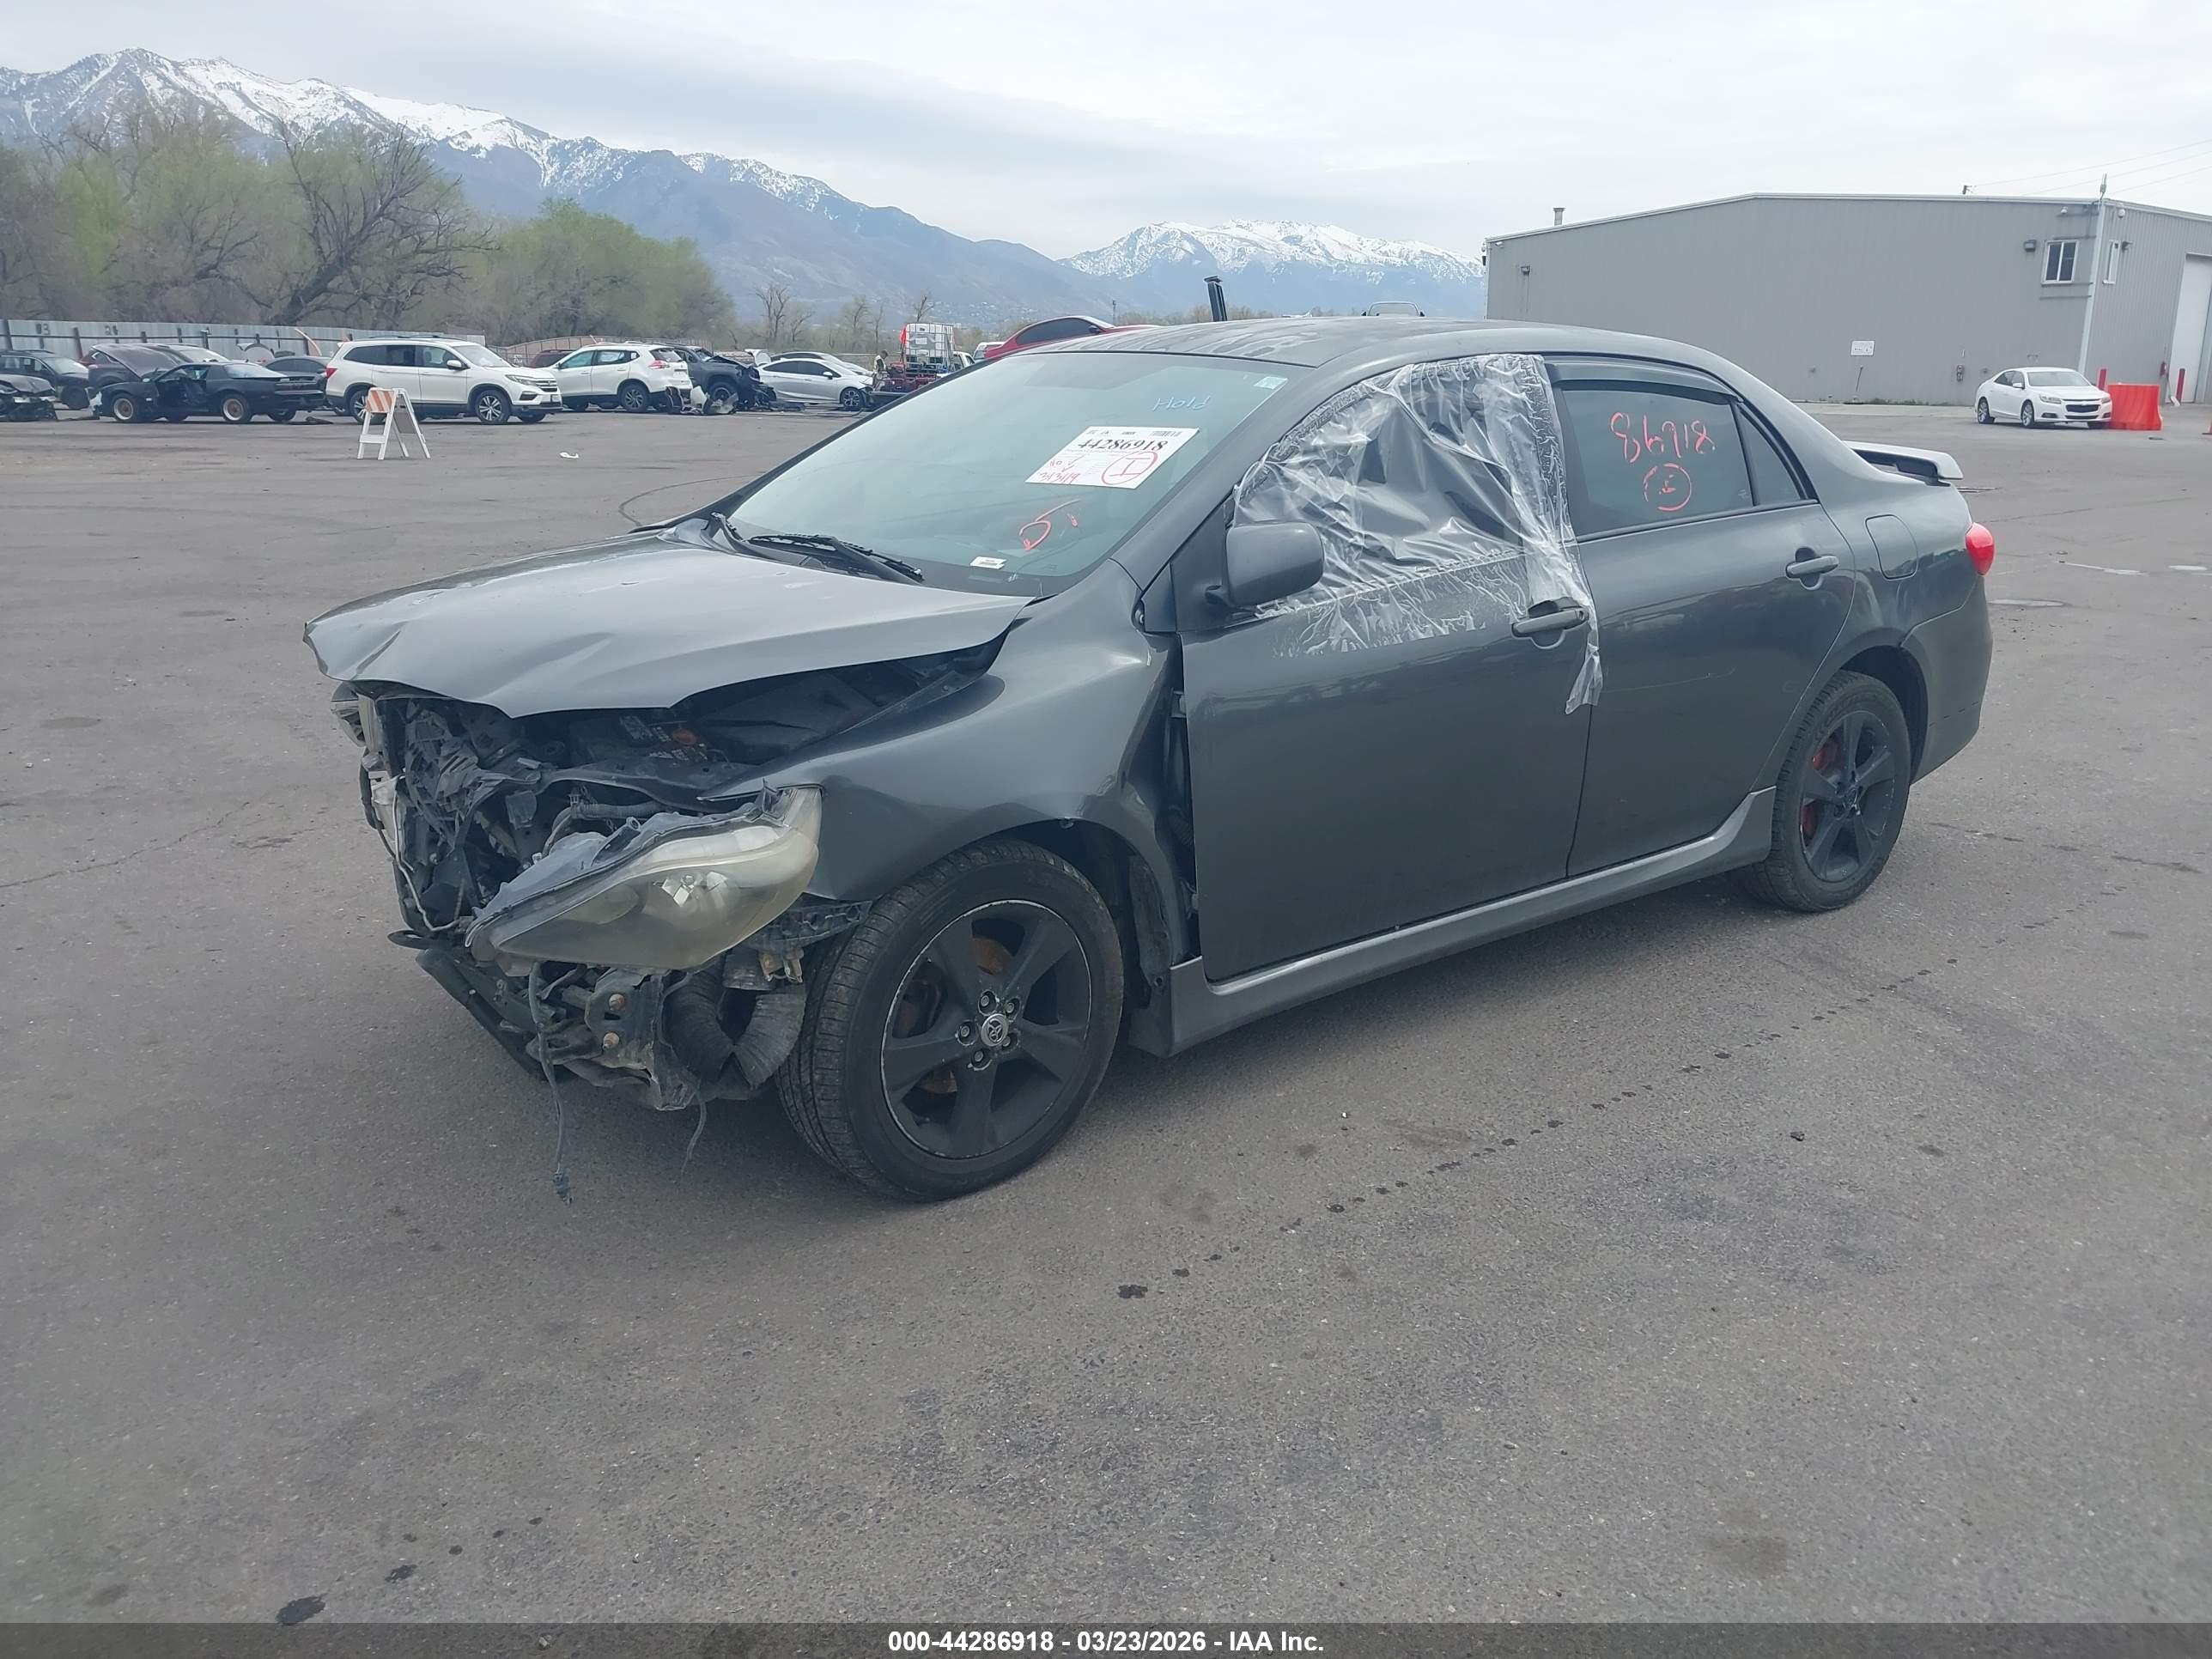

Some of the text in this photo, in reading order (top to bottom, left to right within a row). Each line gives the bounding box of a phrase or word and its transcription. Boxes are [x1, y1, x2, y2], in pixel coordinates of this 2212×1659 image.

[1152, 395, 1211, 411] Hold
[1078, 439, 1169, 452] 44286918
[1609, 411, 1717, 464] 86918
